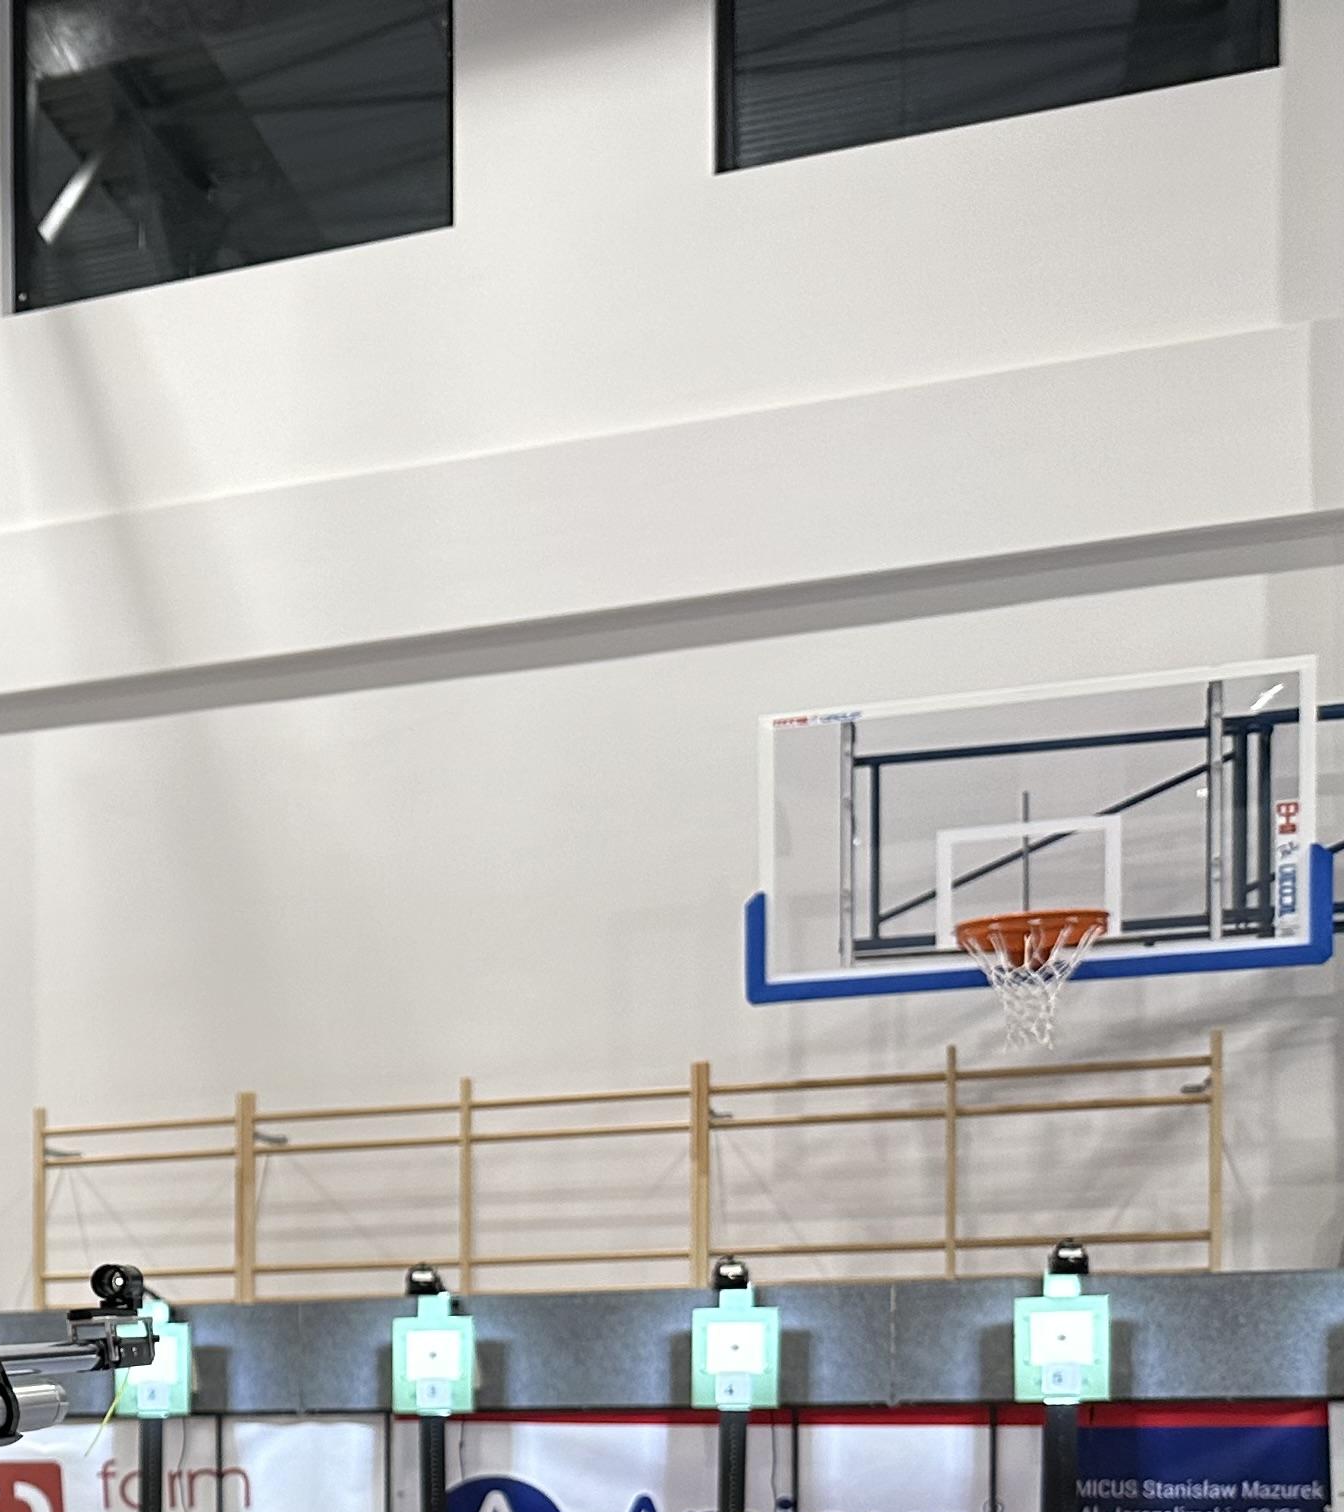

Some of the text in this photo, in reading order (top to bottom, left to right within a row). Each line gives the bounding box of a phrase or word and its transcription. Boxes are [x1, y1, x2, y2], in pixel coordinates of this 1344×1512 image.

[1076, 1479, 1323, 1500] MICUS Stanisław Mazurek
